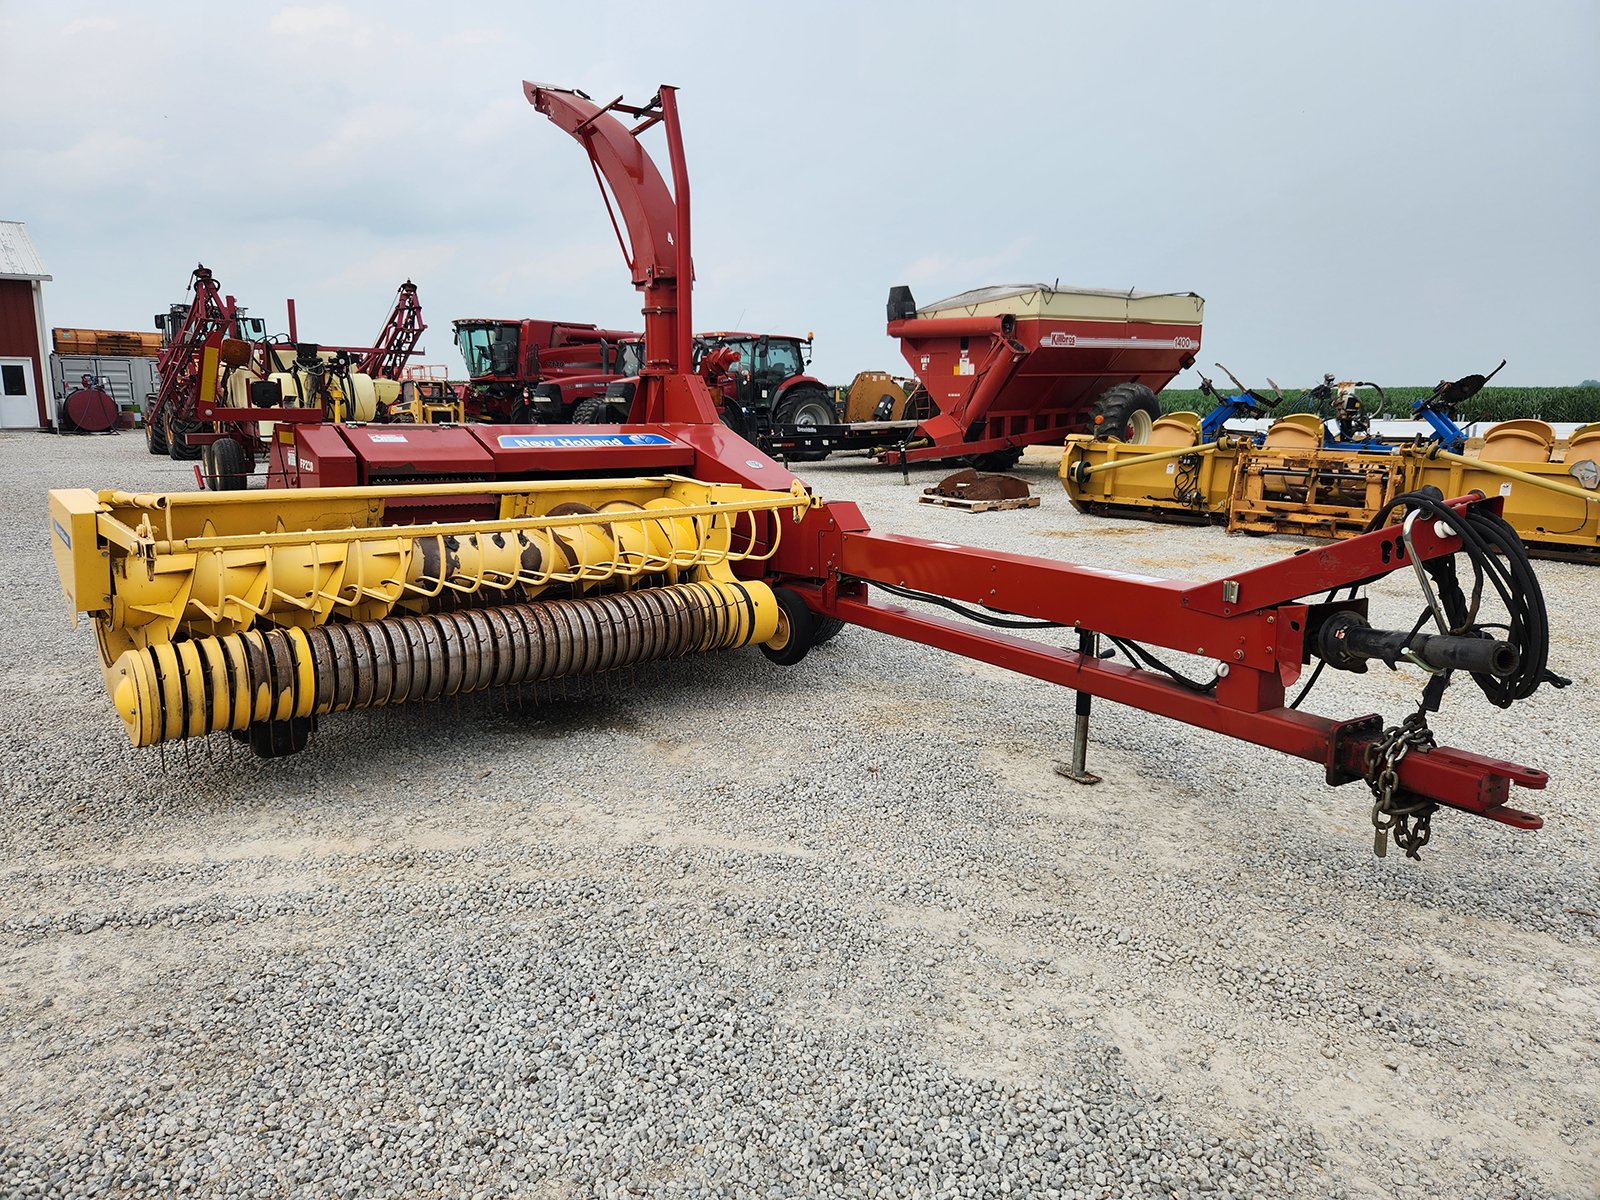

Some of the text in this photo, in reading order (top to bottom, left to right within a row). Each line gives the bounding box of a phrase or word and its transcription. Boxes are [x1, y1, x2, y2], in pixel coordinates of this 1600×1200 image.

[667, 232, 674, 246] 4
[1174, 337, 1191, 348] 1400
[514, 438, 625, 447] New Holland
